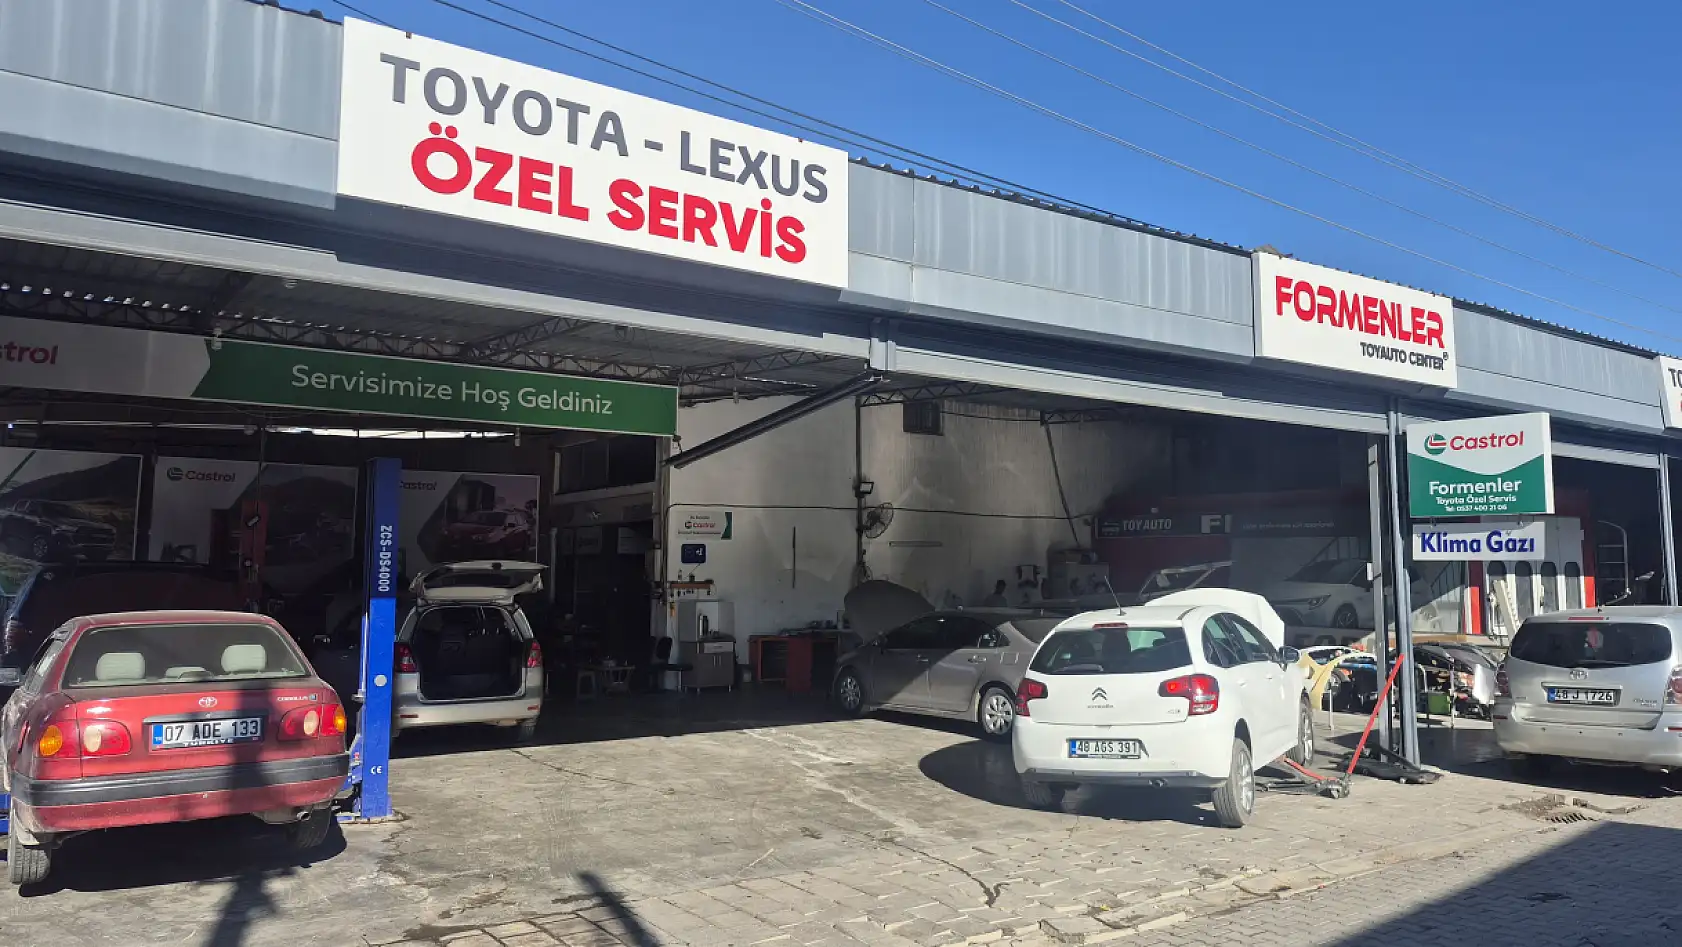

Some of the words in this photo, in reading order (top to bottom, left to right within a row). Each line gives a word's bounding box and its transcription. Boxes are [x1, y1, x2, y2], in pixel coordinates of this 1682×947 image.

[380, 52, 629, 157] TOYOTA
[644, 138, 664, 152] -
[680, 130, 828, 204] LEXUS
[411, 121, 589, 222] ÖZEL
[606, 178, 807, 264] SERVİS
[1275, 275, 1445, 349] FORMENLER
[0, 341, 59, 365] trol
[1360, 342, 1407, 364] TOYAUTO
[291, 364, 453, 400] Servisimize
[461, 381, 511, 411] Hoş
[517, 387, 613, 415] Geldiniz
[1450, 431, 1524, 451] Castrol
[185, 470, 236, 483] Castrol
[1429, 477, 1523, 495] Formenler
[1435, 496, 1465, 505] Toyota
[1466, 494, 1487, 504] Özel
[1488, 494, 1517, 503] Servis
[1420, 531, 1482, 553] Klima
[1486, 530, 1535, 553] Gazı
[378, 525, 393, 592] ZCS-DS4000
[1573, 689, 1579, 699] J
[165, 725, 184, 742] 07
[192, 722, 222, 741] ADE
[232, 720, 259, 737] 133
[1077, 740, 1090, 753] 48
[1094, 740, 1114, 753] AGS
[1118, 741, 1137, 753] 391
[370, 765, 383, 775] CE
